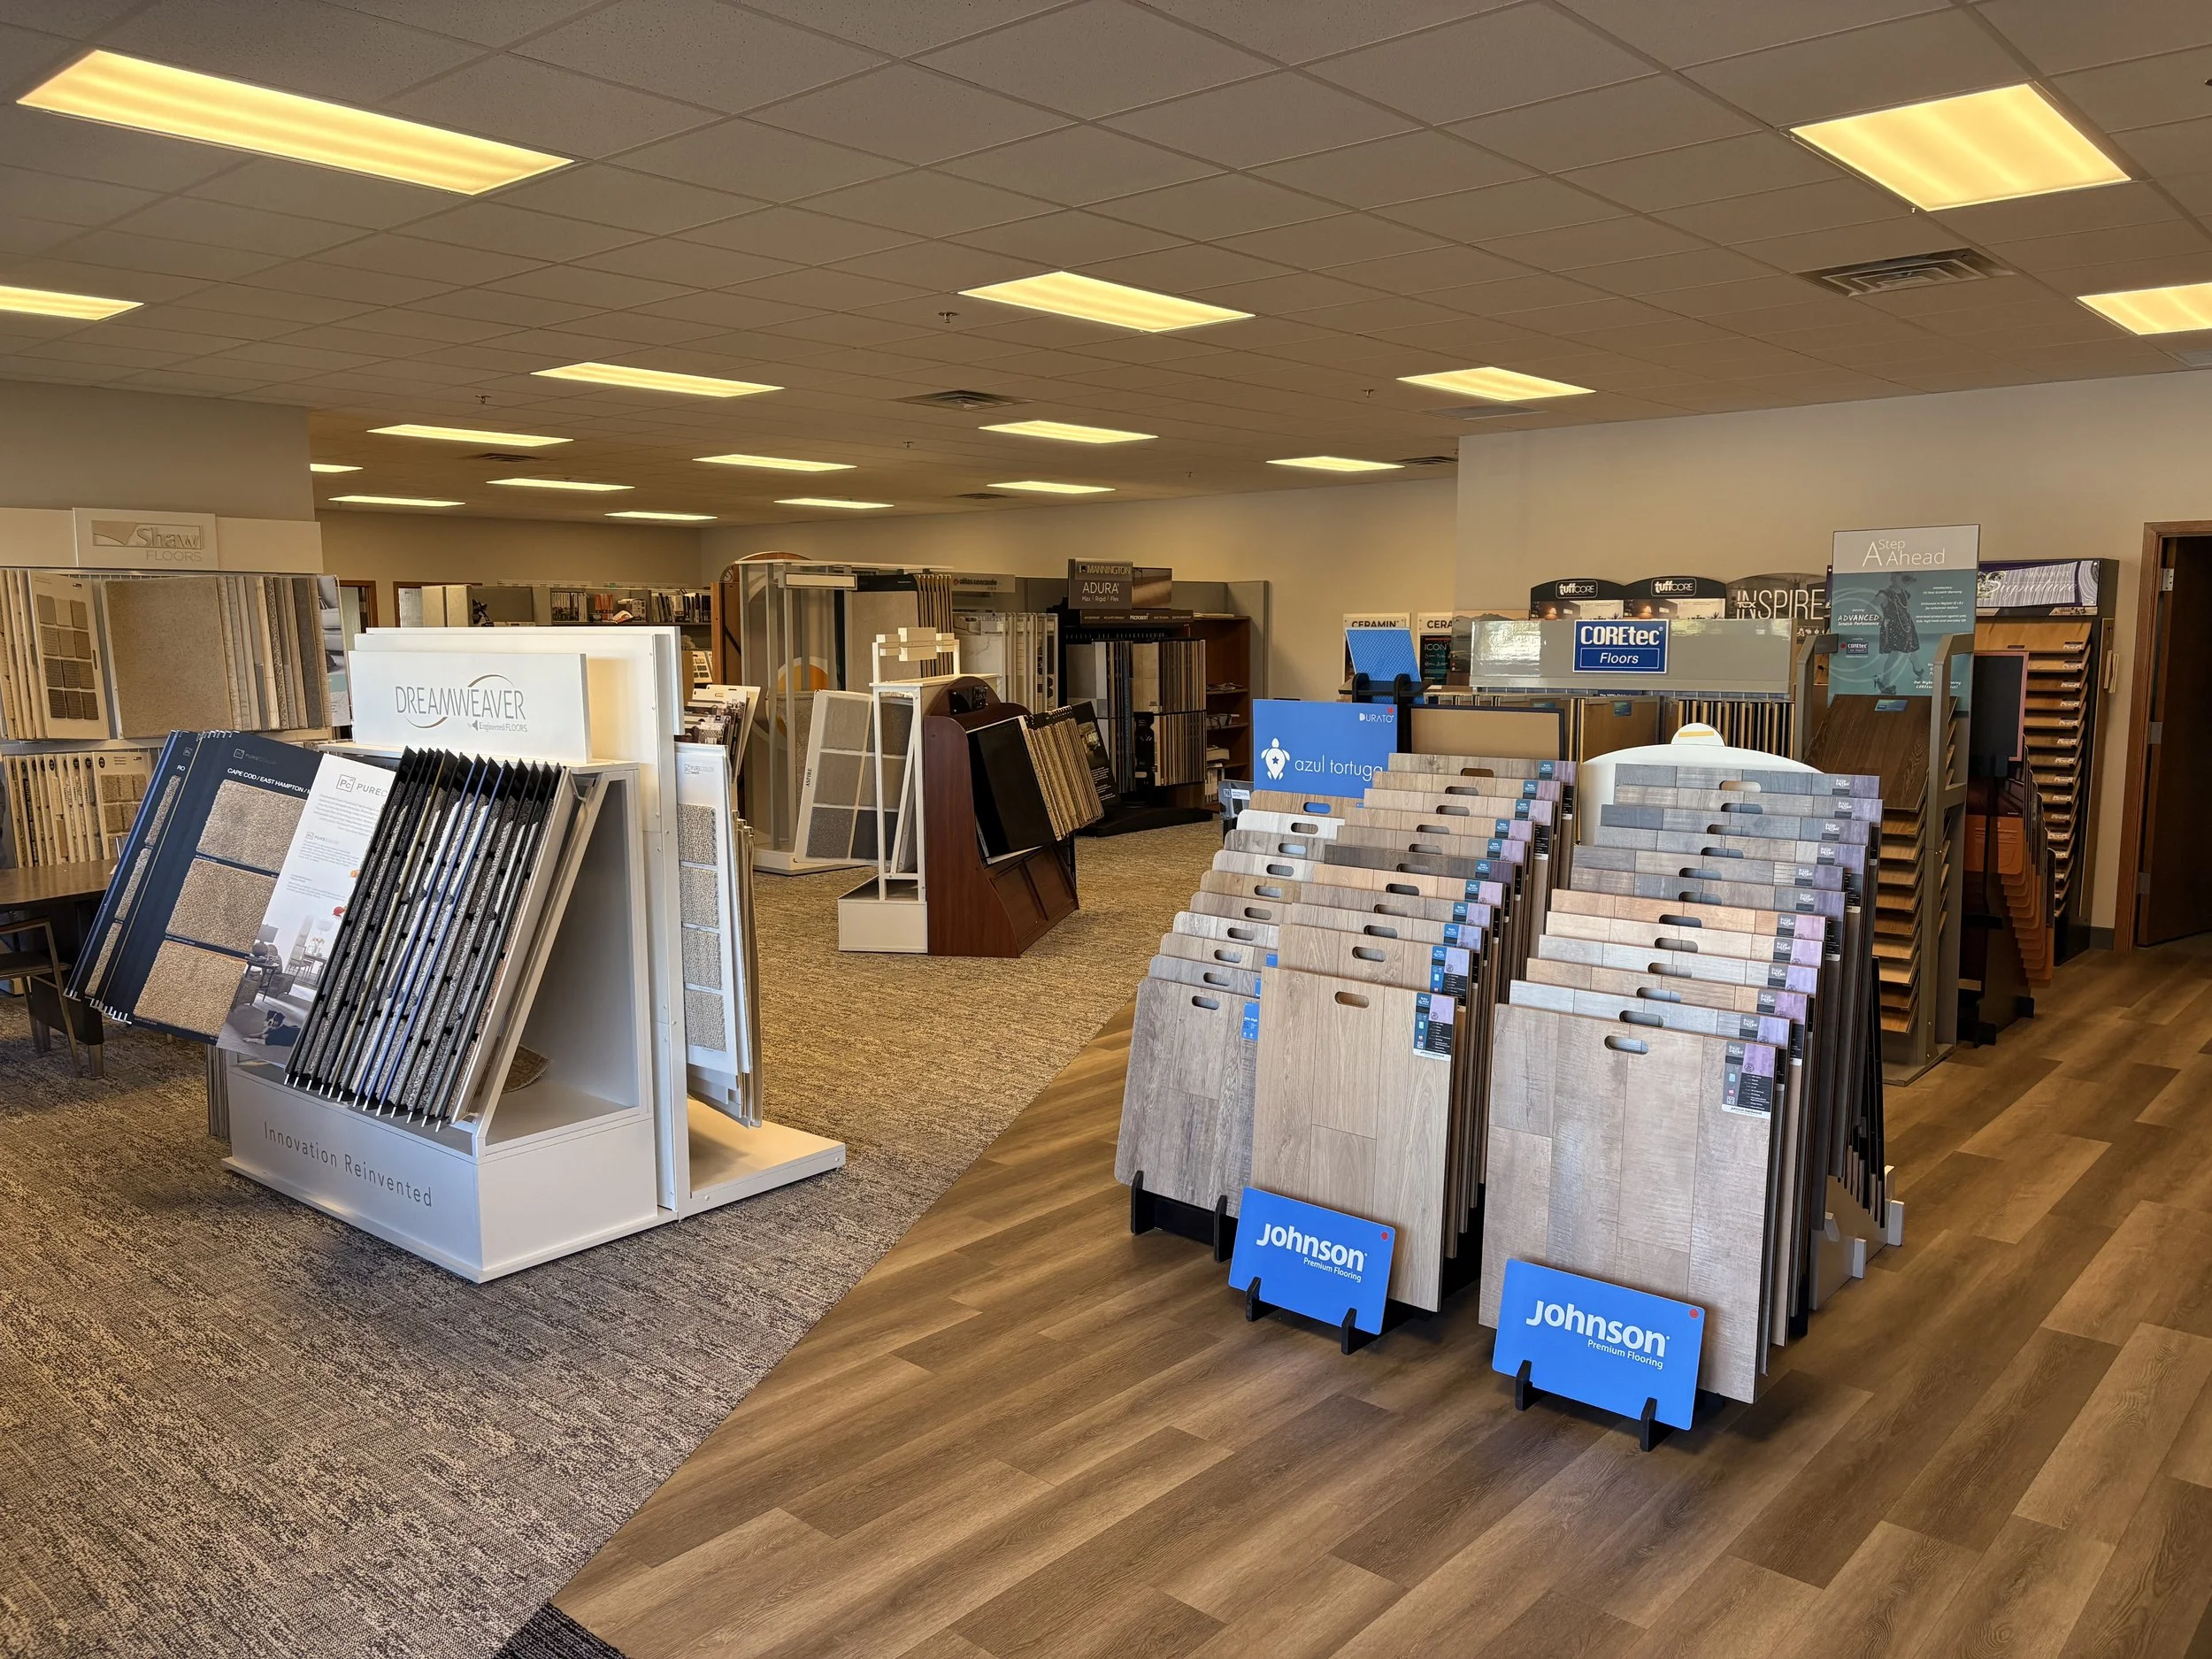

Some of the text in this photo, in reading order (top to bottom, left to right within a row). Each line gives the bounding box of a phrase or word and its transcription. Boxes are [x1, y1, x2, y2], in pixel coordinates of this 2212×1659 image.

[136, 527, 200, 548] Shaw
[1878, 539, 1906, 551] Step
[146, 549, 203, 562] FLOORS
[1886, 548, 1946, 566] Ahead
[1087, 565, 1131, 574] MANNINGTON
[1082, 581, 1118, 594] ADURA
[1427, 620, 1452, 629] CERA
[1600, 652, 1640, 664] Floors
[396, 686, 526, 720] DREAMWEAVER
[1294, 754, 1325, 773] azul
[227, 767, 244, 777] CAPE
[243, 772, 257, 780] COD
[260, 776, 275, 786] EAST
[274, 780, 304, 793] HAMPTON
[356, 783, 388, 797] PUREC
[264, 1120, 433, 1208] Innovation Reinvented
[1256, 1223, 1365, 1272] Johnson
[1303, 1256, 1363, 1283] Premium Flooring
[1525, 1300, 1667, 1358] Johnson
[1587, 1340, 1663, 1371] Premium Flooring
